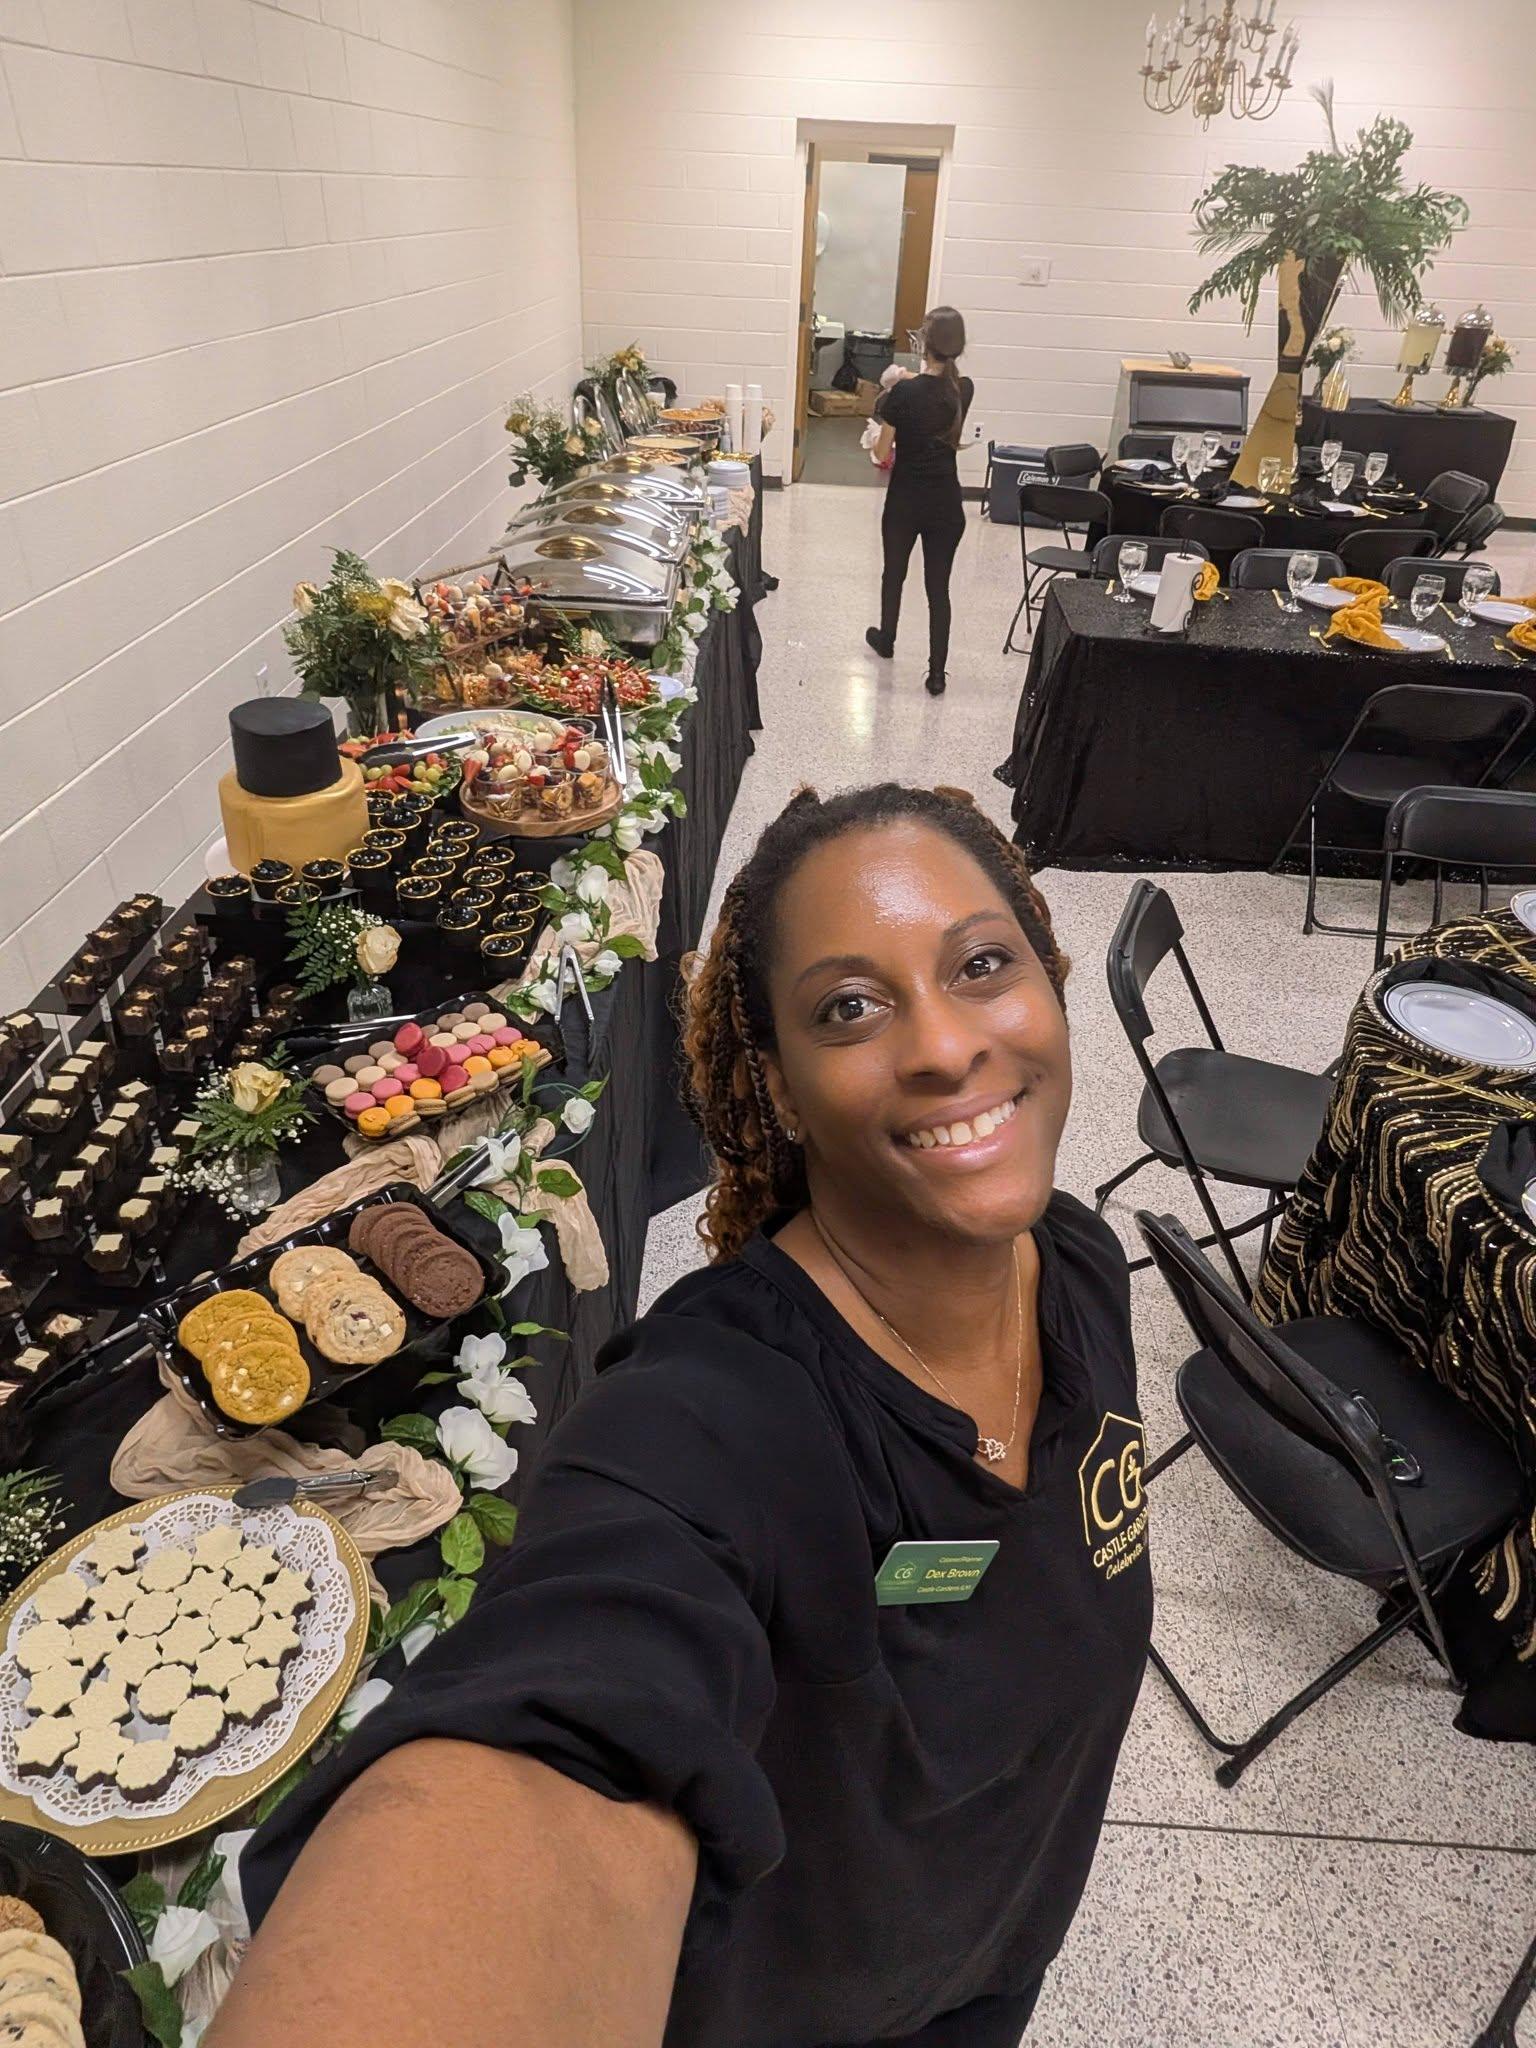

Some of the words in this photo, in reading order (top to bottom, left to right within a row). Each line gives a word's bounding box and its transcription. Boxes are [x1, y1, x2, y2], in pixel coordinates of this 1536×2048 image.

[1091, 1440, 1144, 1530] CG
[1093, 1531, 1127, 1568] CASTLE
[894, 1567, 914, 1579] CG
[925, 1569, 947, 1579] Dex
[947, 1568, 980, 1578] Brown
